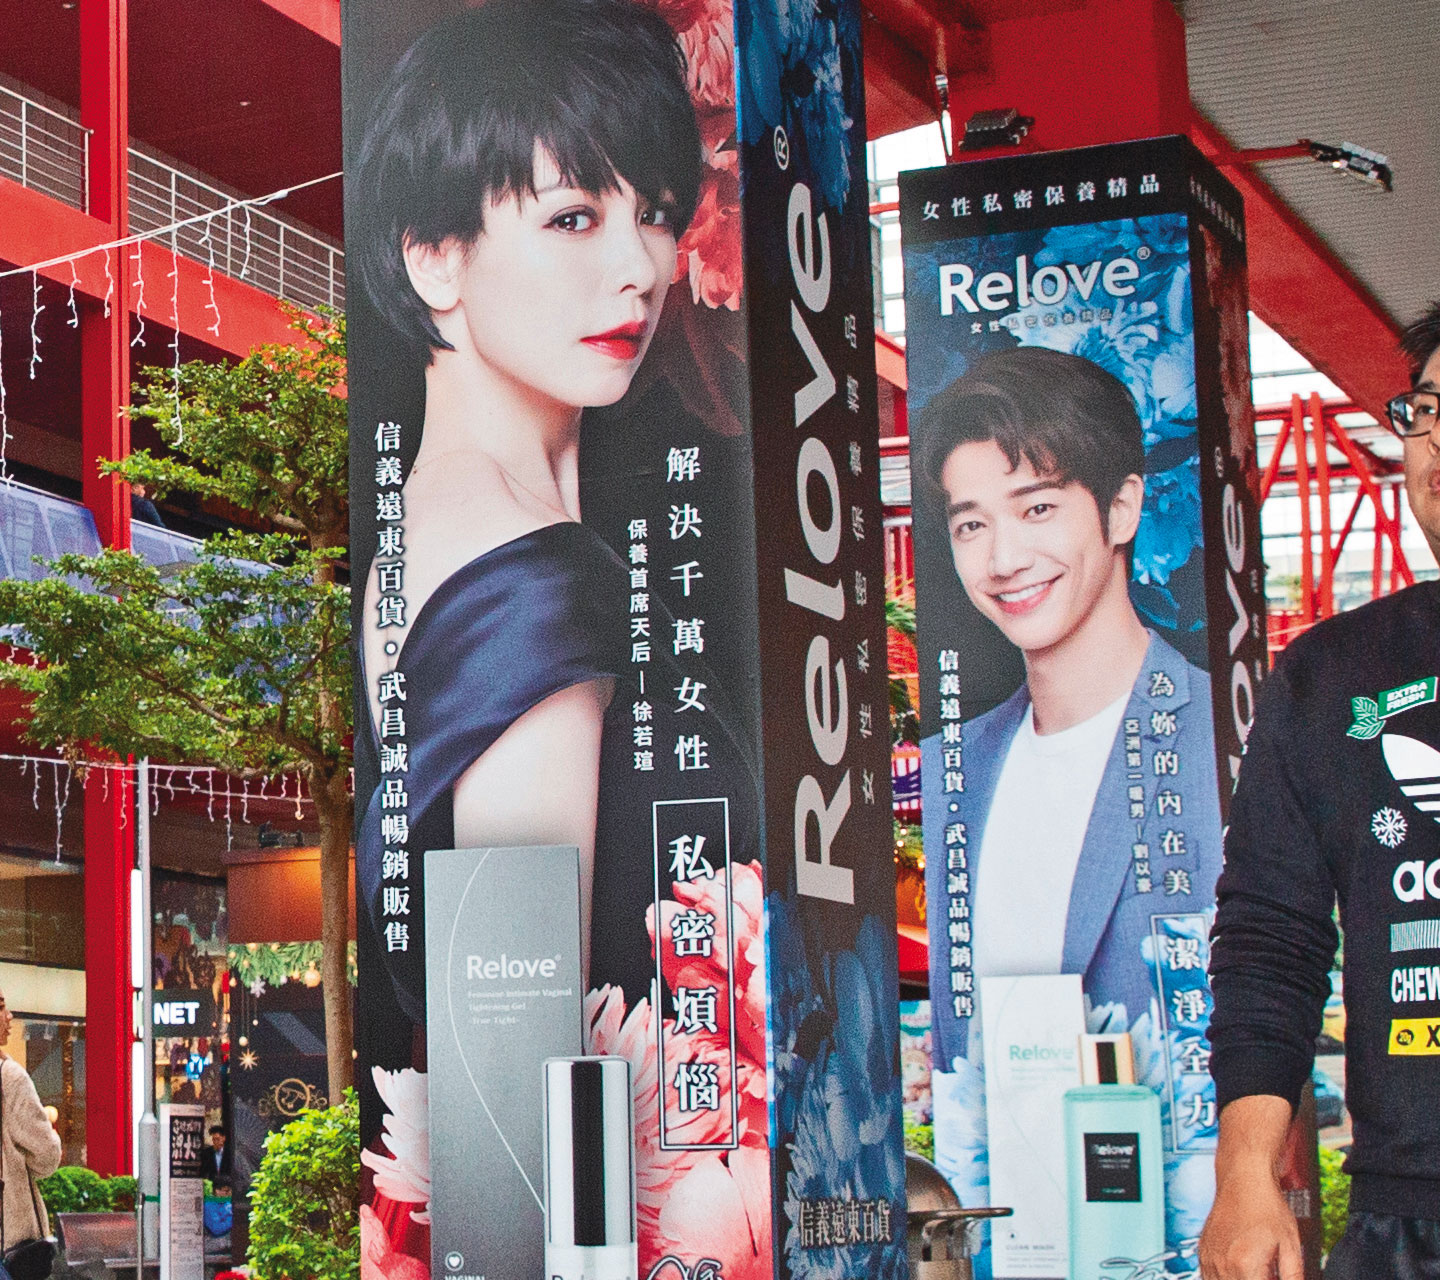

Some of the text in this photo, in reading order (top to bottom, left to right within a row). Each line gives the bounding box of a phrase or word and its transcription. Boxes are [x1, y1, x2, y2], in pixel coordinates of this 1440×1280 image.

[923, 173, 1161, 221] 女性私密保養精品
[666, 446, 710, 771] 解決千萬女性
[1150, 671, 1192, 897] 為妳的內在美
[154, 1001, 200, 1025] NET
[668, 832, 720, 1112] 私密煩惱
[1165, 937, 1213, 1128] 潔淨全力
